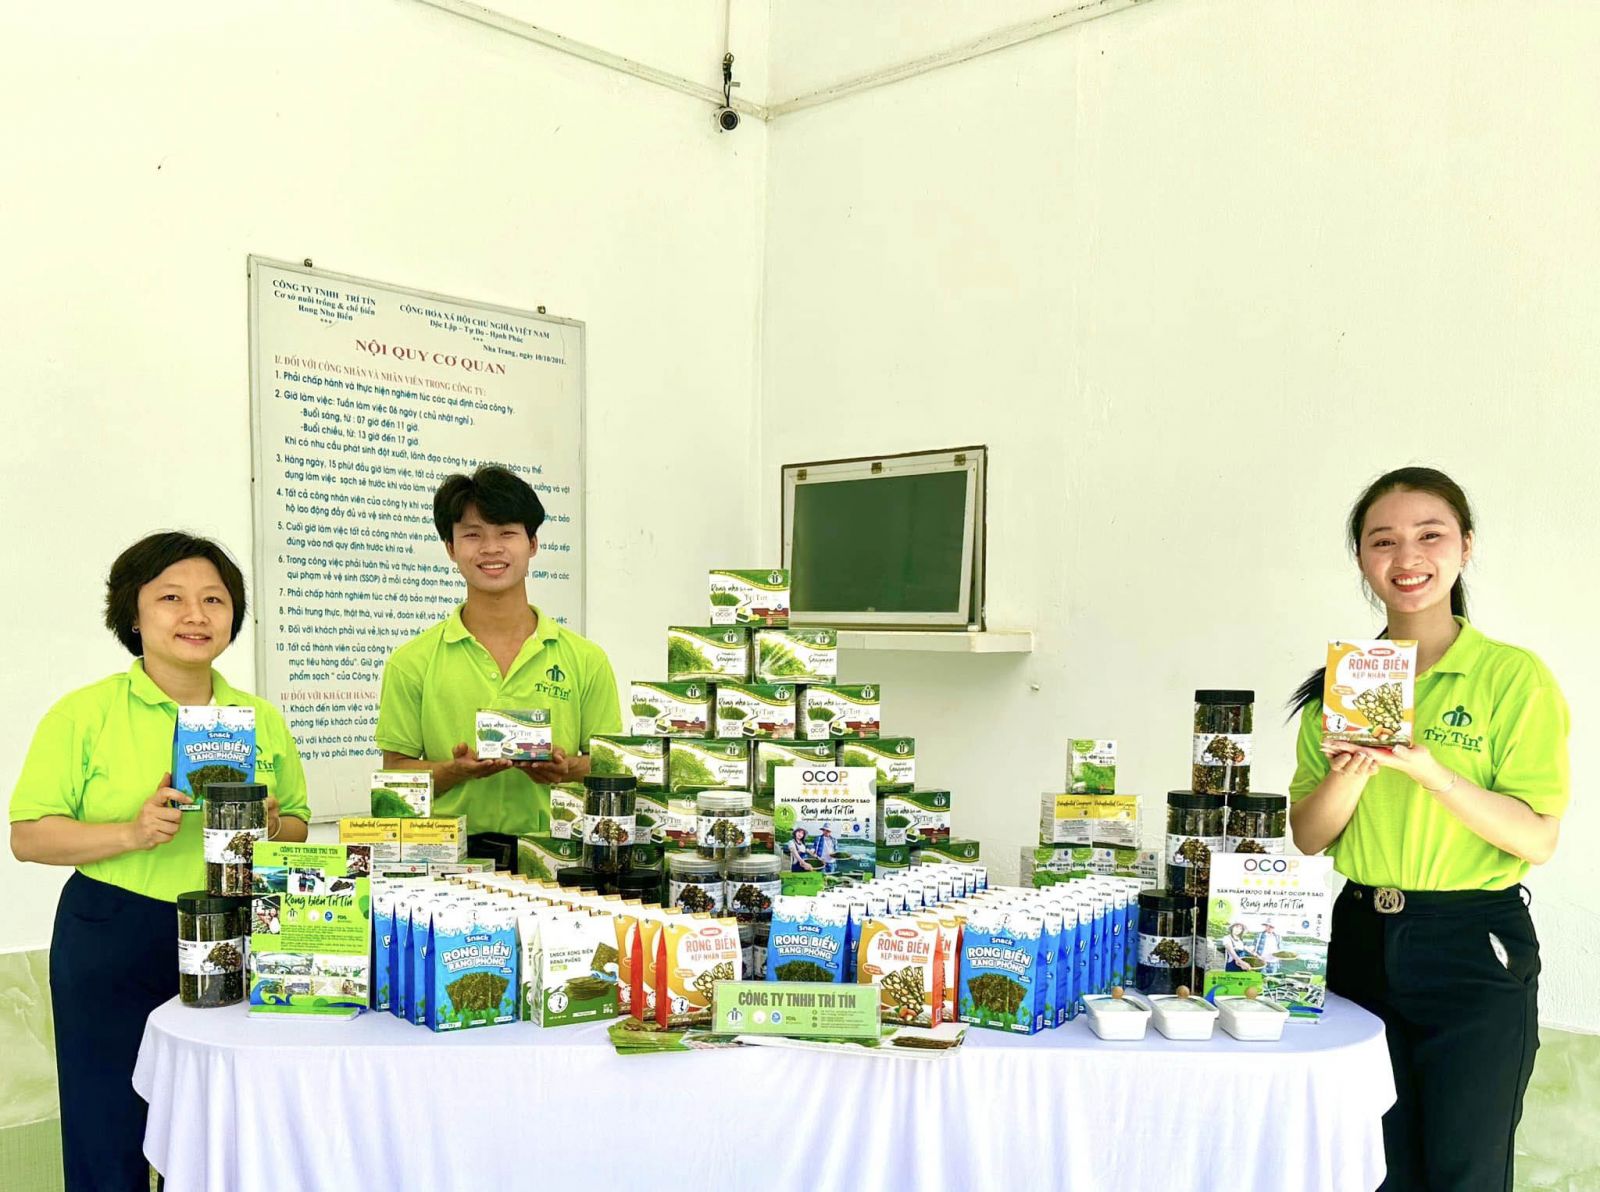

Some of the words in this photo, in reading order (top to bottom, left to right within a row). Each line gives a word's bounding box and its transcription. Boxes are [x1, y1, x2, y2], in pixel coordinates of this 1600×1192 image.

[272, 279, 299, 291] CÔNG
[300, 285, 312, 294] TY
[314, 287, 338, 299] TNHH
[345, 294, 360, 303] TRÍ
[361, 296, 376, 306] TÍN
[274, 289, 286, 299] Cơ
[337, 302, 344, 310] &
[298, 304, 317, 316] Rong
[319, 307, 335, 318] Nho
[399, 304, 423, 315] CỘNG
[456, 314, 470, 325] HỘI
[514, 326, 533, 336] VIỆT
[533, 330, 550, 339] NAM
[475, 327, 484, 336] Do
[482, 344, 496, 353] Nha
[355, 339, 386, 357] NỘI
[392, 346, 428, 362] QUY
[432, 353, 457, 367] CƠ
[460, 358, 505, 375] QUAN
[283, 371, 300, 382] Phải
[474, 399, 488, 411] của
[372, 403, 387, 414] việc
[388, 405, 397, 415] 06
[423, 409, 436, 420] chủ
[356, 415, 365, 425] 07
[397, 420, 404, 430] 11
[358, 429, 365, 440] 13
[397, 435, 405, 444] 17
[1348, 658, 1378, 670] RONG
[208, 731, 231, 739] snack
[185, 741, 221, 755] RONG
[223, 738, 251, 754] BIỂN
[191, 752, 215, 761] RANG
[803, 770, 849, 783] OCOP
[1244, 858, 1300, 873] OCOP
[285, 892, 306, 910] Rong
[1240, 897, 1262, 912] Rong
[1263, 898, 1278, 909] nho
[799, 925, 821, 934] snack
[467, 934, 490, 943] snack
[685, 939, 712, 953] RONG
[775, 935, 809, 947] RONG
[811, 934, 838, 952] BIỂN
[877, 937, 904, 952] RONG
[992, 937, 1014, 946] snack
[442, 946, 480, 963] RONG
[482, 940, 511, 957] BIỂN
[780, 946, 802, 954] RANG
[967, 947, 1002, 959] RONG
[1003, 947, 1031, 966] BIỂN
[450, 958, 474, 971] RANG
[971, 959, 995, 967] RANG
[738, 988, 769, 1007] CÔNG
[770, 992, 785, 1007] TY
[786, 992, 816, 1008] TNHH
[817, 991, 836, 1009] TRÍ
[838, 991, 856, 1009] TÍN
